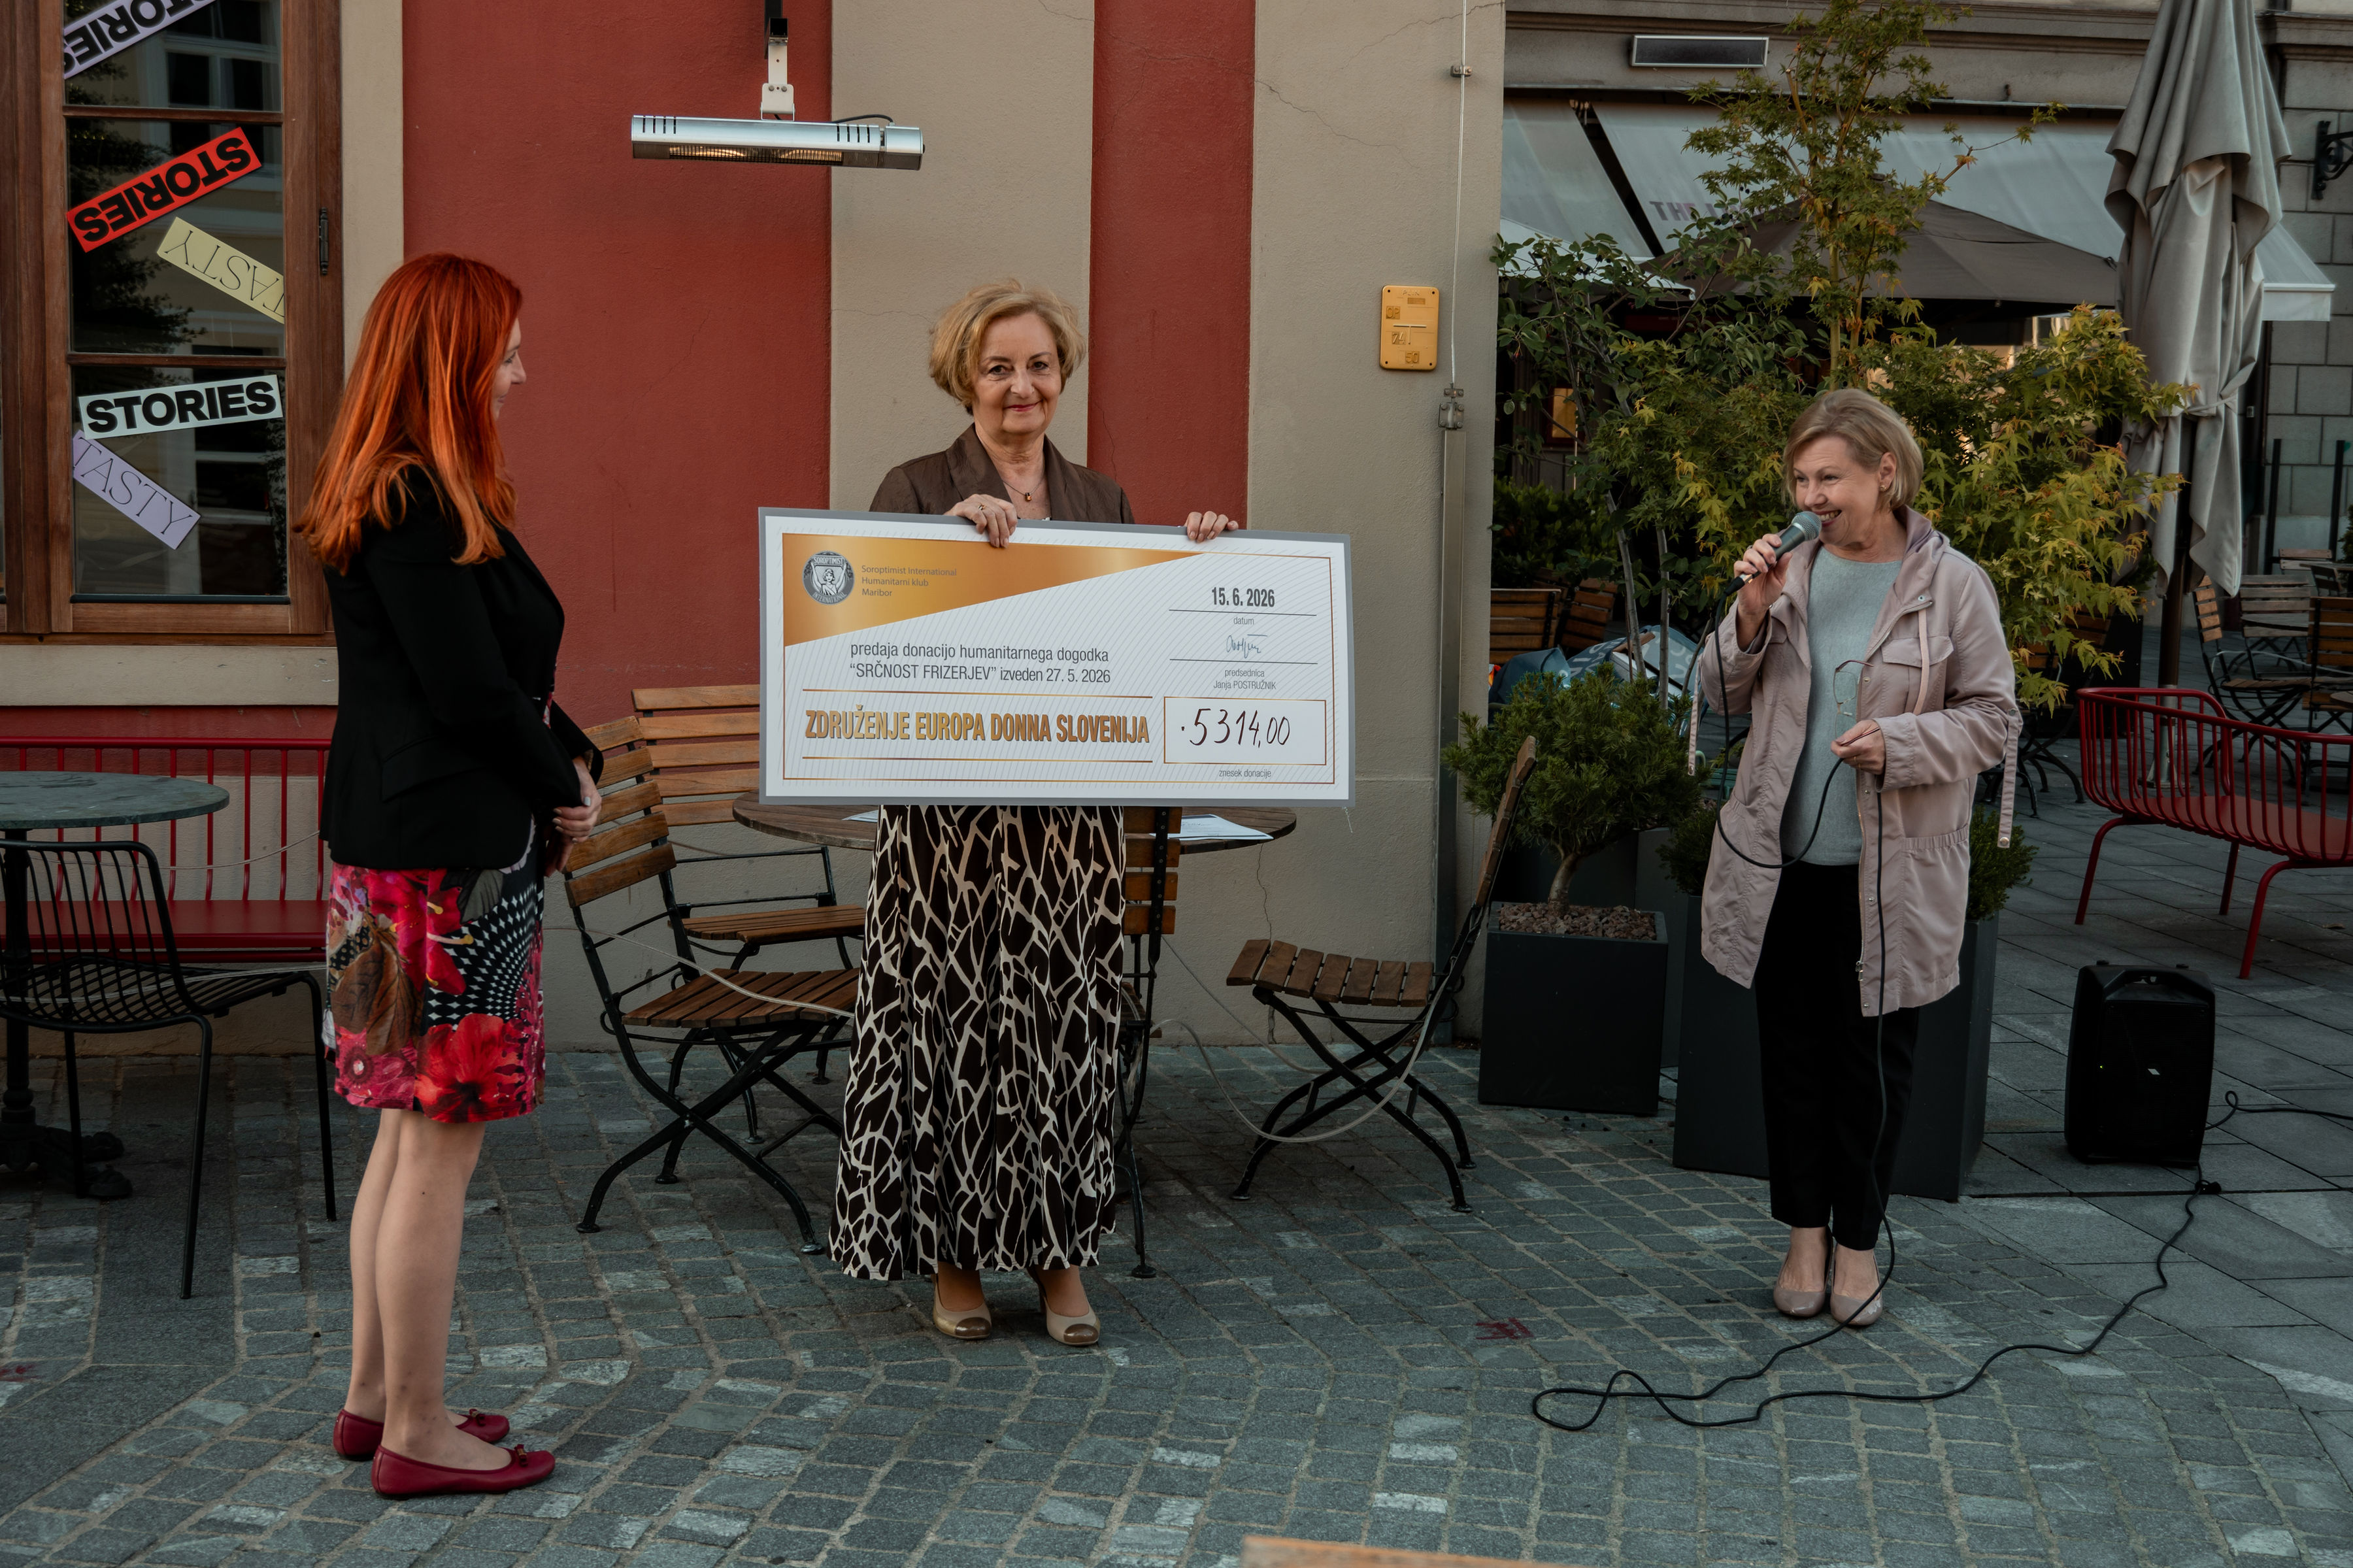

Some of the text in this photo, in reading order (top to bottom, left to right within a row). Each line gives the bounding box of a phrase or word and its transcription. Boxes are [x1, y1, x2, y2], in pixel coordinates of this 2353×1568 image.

[64, 0, 204, 74] TORIE
[74, 137, 252, 242] STORIES
[164, 230, 285, 318] TASTY
[86, 381, 277, 433] STORIES
[72, 436, 193, 535] TASTY
[814, 556, 843, 565] SOROPTIMIST
[861, 565, 957, 576] Soroptimist International
[861, 577, 910, 586] Humanitarni
[861, 588, 892, 597] Maribor
[1211, 586, 1275, 607] 15. 6. 2026
[1233, 616, 1254, 626] datum
[850, 642, 1109, 664] predaja donacijo humanitarnega dogodka
[1000, 667, 1043, 682] izveden
[1046, 668, 1064, 682] 27.
[1067, 669, 1078, 682] 5.
[1082, 669, 1111, 683] 2026
[1224, 669, 1265, 678] predsednica
[1213, 679, 1277, 691] Janja POSTRUŽNIK
[805, 704, 1150, 743] ZDRUŽENJE EUROPA DONNA SLOVENIJA
[1218, 769, 1272, 778] znesek donacije
